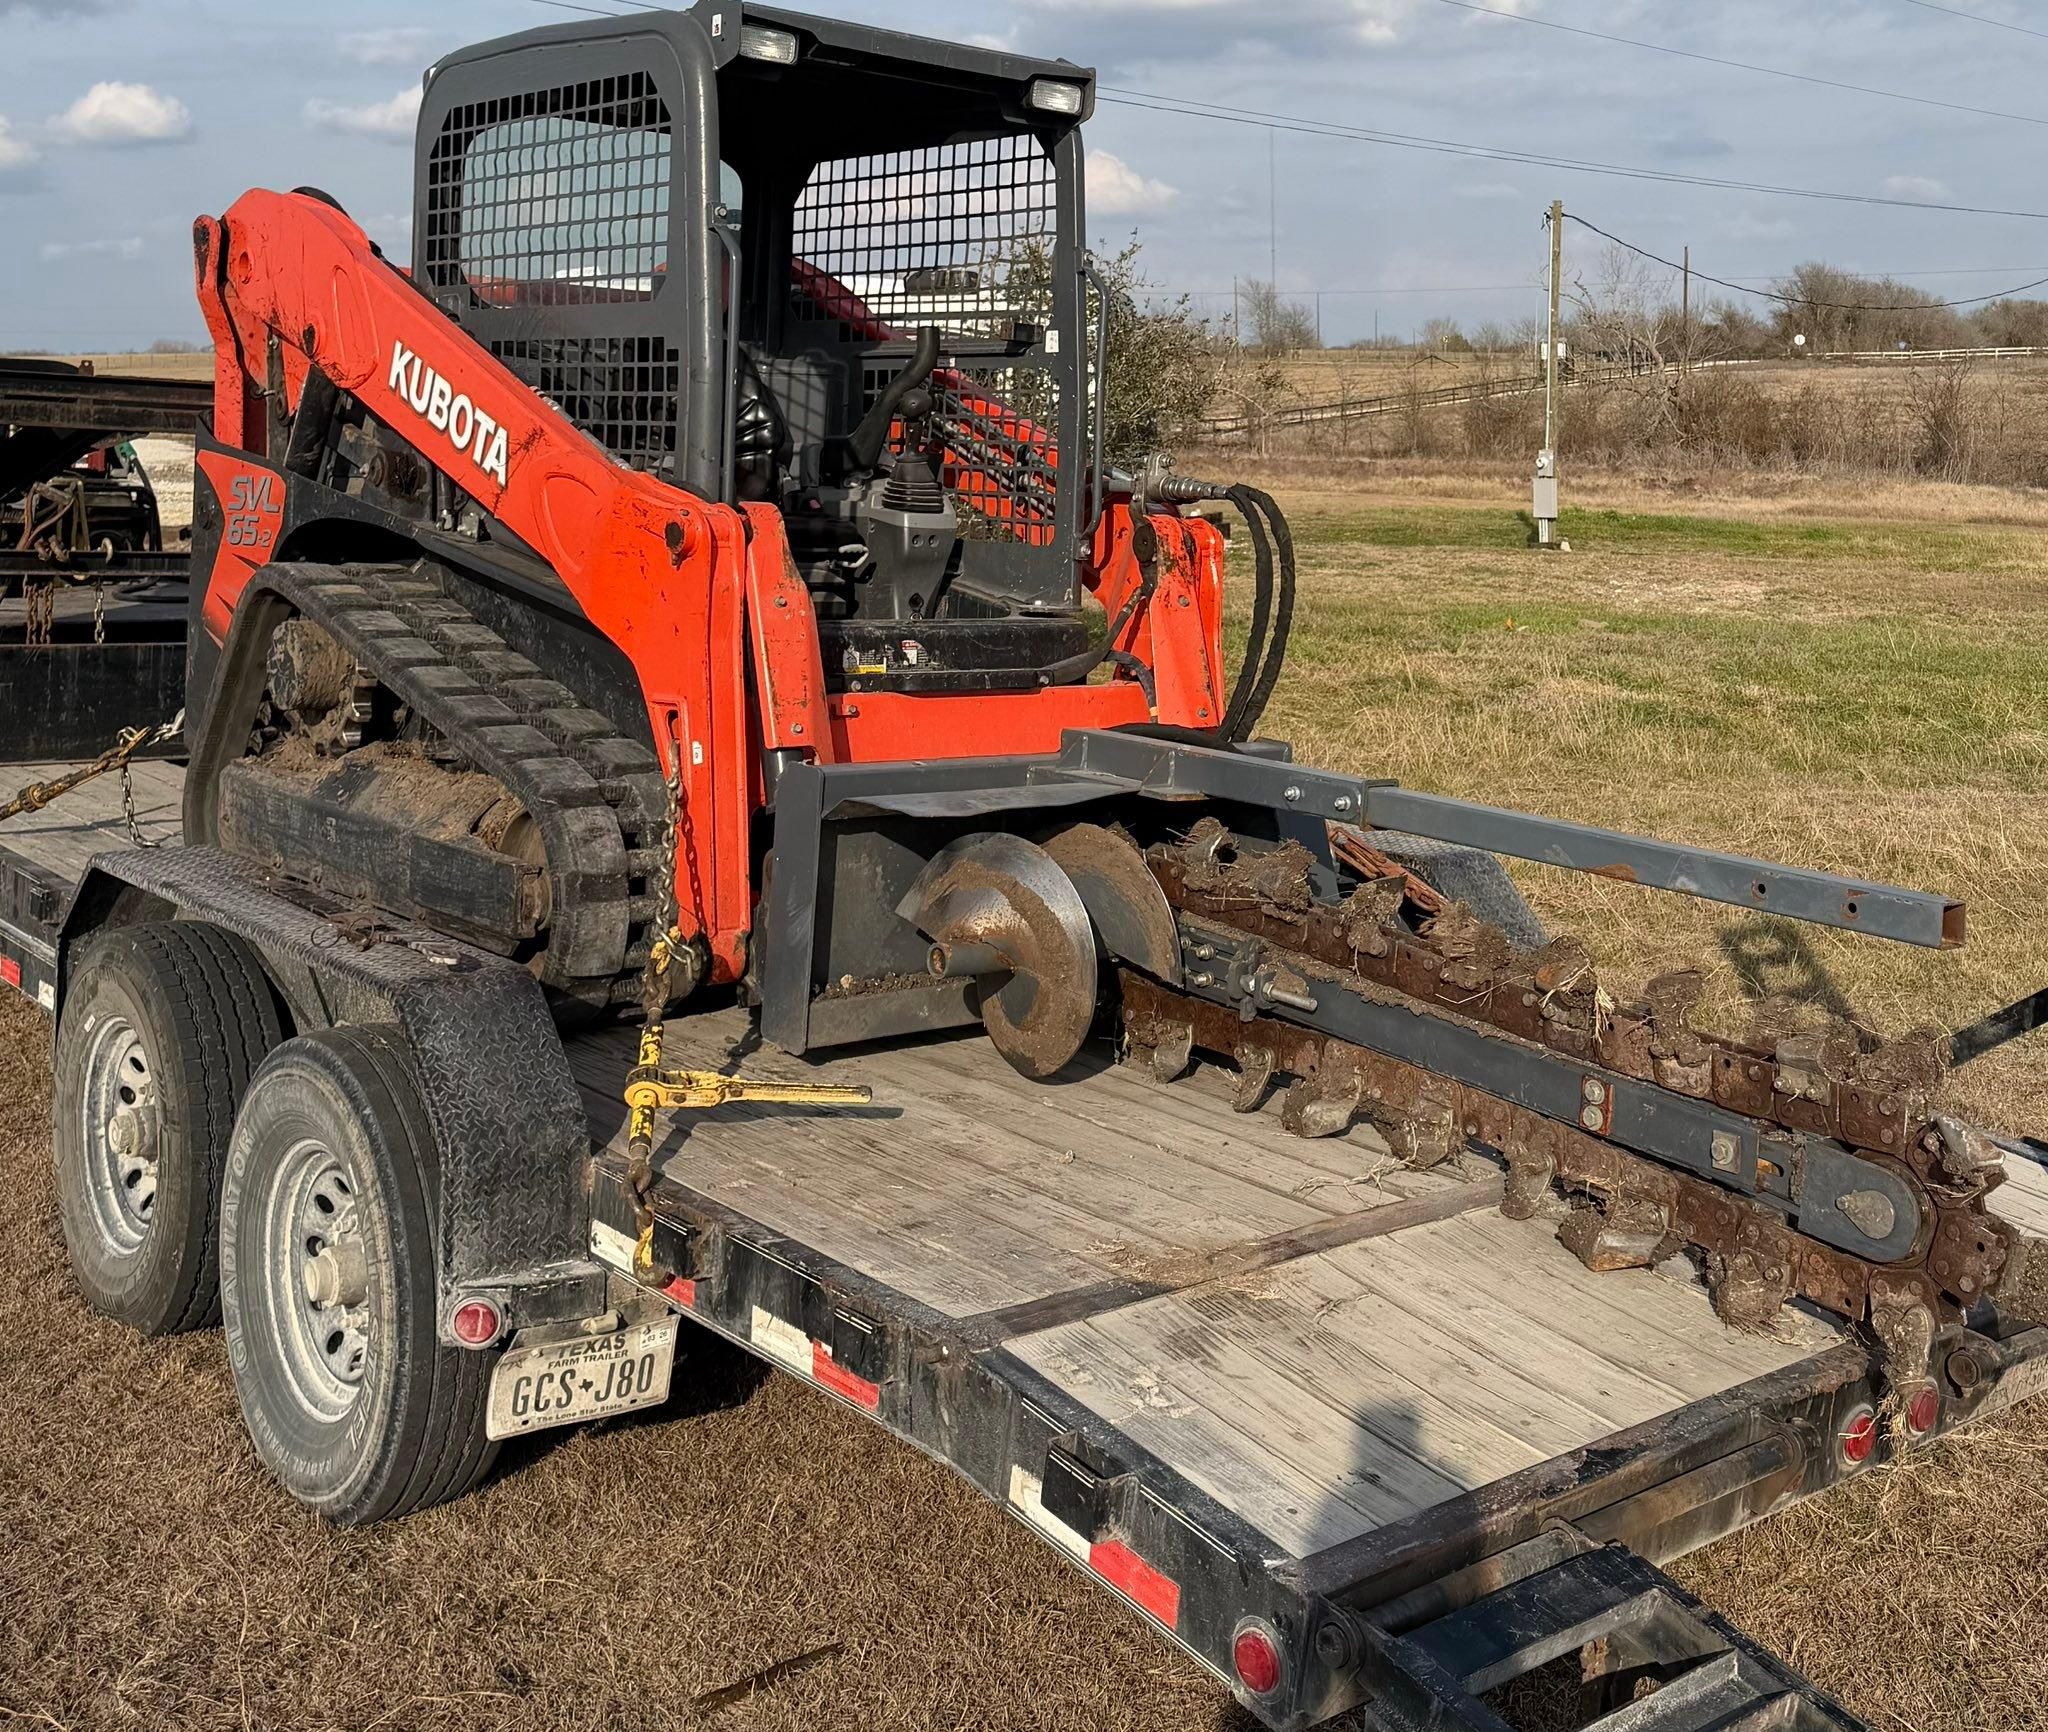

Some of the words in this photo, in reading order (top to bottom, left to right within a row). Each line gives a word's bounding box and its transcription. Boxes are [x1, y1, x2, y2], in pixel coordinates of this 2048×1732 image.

[388, 339, 508, 486] KUBOTA
[228, 475, 280, 513] SVL
[227, 515, 272, 547] 65-2
[222, 1127, 256, 1373] GLADIATOR
[547, 1355, 580, 1370] FARM
[583, 1349, 629, 1363] TRAILER
[558, 1333, 627, 1359] TEXAS
[512, 1368, 577, 1417] GCS
[594, 1353, 656, 1403] J80
[537, 1415, 554, 1424] The
[555, 1411, 578, 1421] Lone
[579, 1407, 599, 1416] Star
[600, 1403, 623, 1412] State
